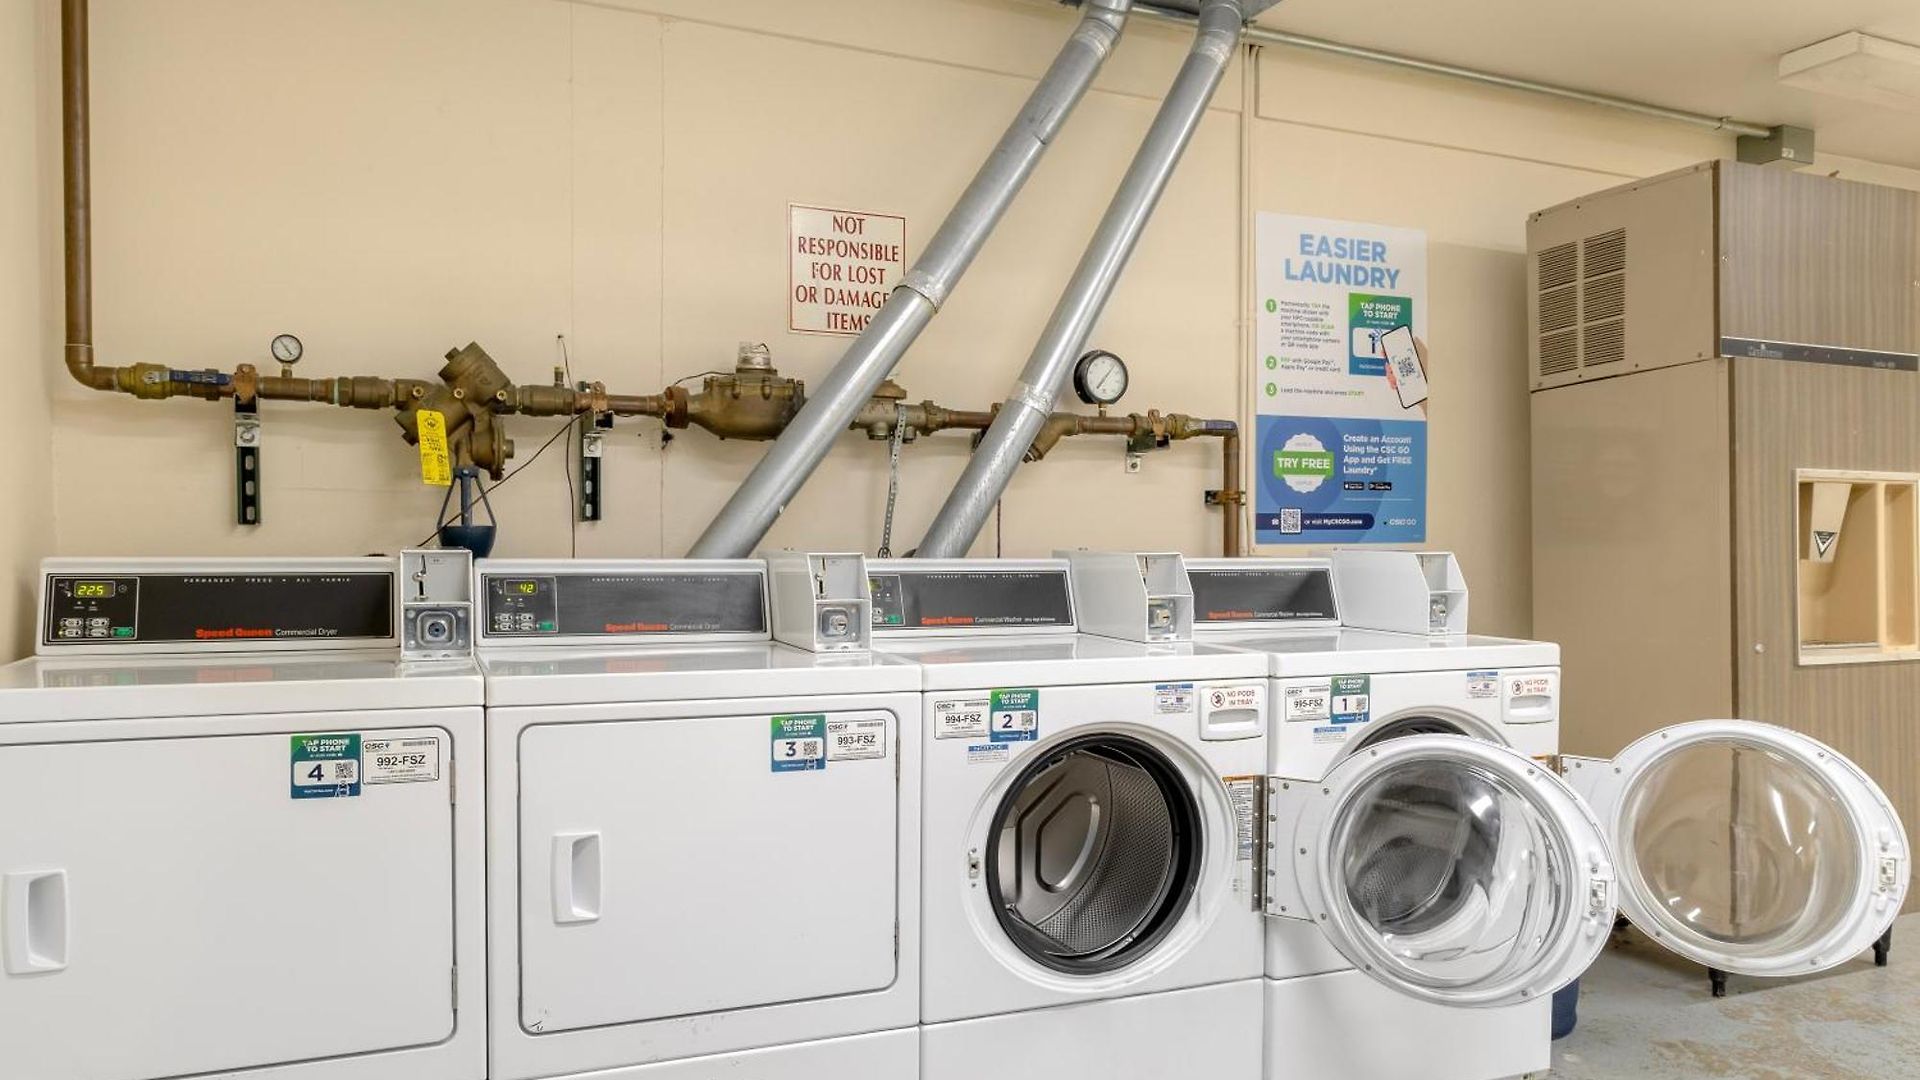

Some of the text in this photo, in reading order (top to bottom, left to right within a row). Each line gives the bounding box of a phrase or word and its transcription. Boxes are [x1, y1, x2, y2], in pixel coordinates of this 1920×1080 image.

[832, 215, 866, 235] NOT
[798, 236, 899, 262] RESPONSIBLE
[1300, 234, 1386, 263] EASIER
[812, 262, 886, 285] FOR LOST
[1284, 258, 1400, 290] LAUNDRY
[796, 285, 890, 309] OR DAMAGE
[1376, 304, 1400, 312] PHONE
[1374, 311, 1398, 319] START
[1344, 434, 1412, 444] Create an Account
[1344, 445, 1410, 454] Using the CSC GO
[1278, 457, 1330, 469] TRY FREE
[1344, 456, 1360, 465] App
[1361, 456, 1376, 464] and
[1377, 456, 1390, 464] Get
[78, 585, 104, 596] 225
[520, 583, 533, 593] 42
[196, 627, 232, 639] Speed
[234, 627, 272, 637] Queen
[318, 628, 338, 637] Dryer
[1294, 698, 1323, 708] 995-FSZ
[1342, 698, 1347, 711] 1
[945, 714, 981, 724] 994-FSZ
[1002, 714, 1013, 728] 2
[302, 738, 349, 747] TAP PHONE
[838, 735, 876, 746] 993-FSZ
[785, 741, 796, 757] 3
[377, 755, 426, 767] 992-FSZ
[308, 763, 324, 781] 4
